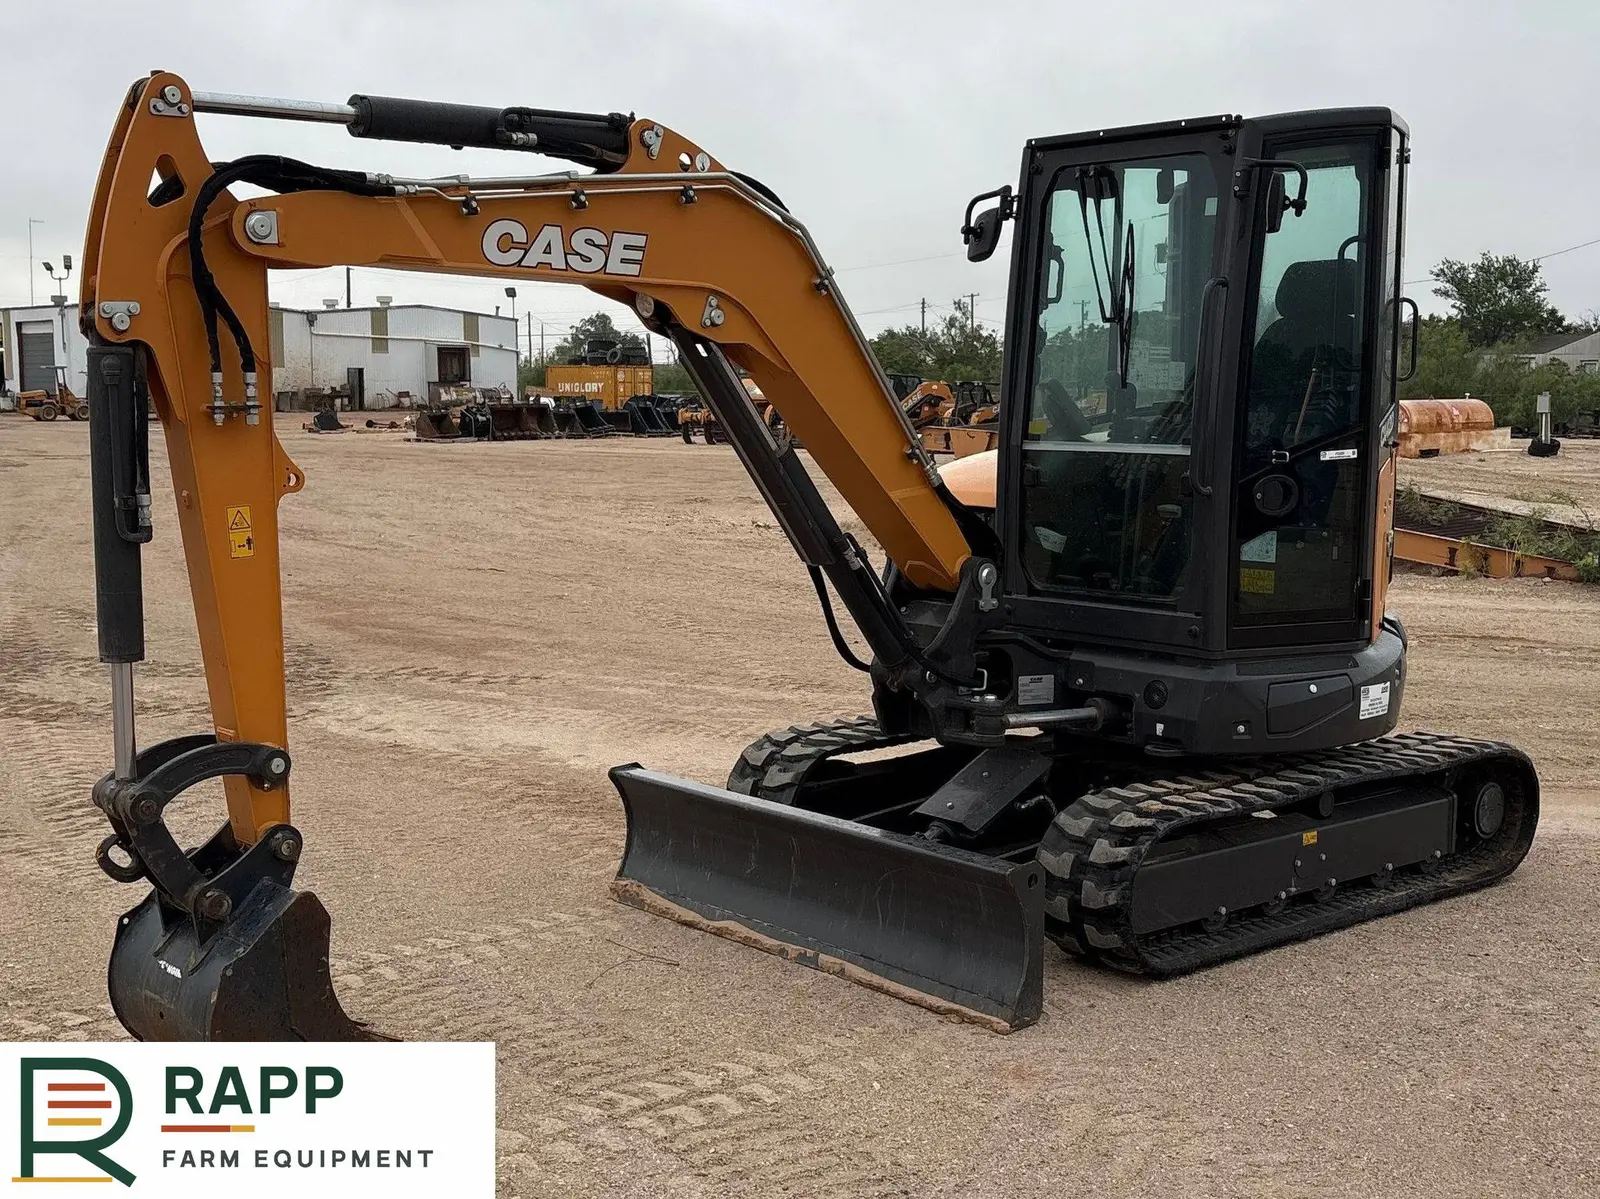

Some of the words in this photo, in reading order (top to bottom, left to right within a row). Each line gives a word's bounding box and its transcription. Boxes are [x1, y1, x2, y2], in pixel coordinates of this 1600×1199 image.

[481, 219, 648, 277] CASE
[558, 382, 604, 393] UNIGLORY
[902, 390, 923, 411] CASE
